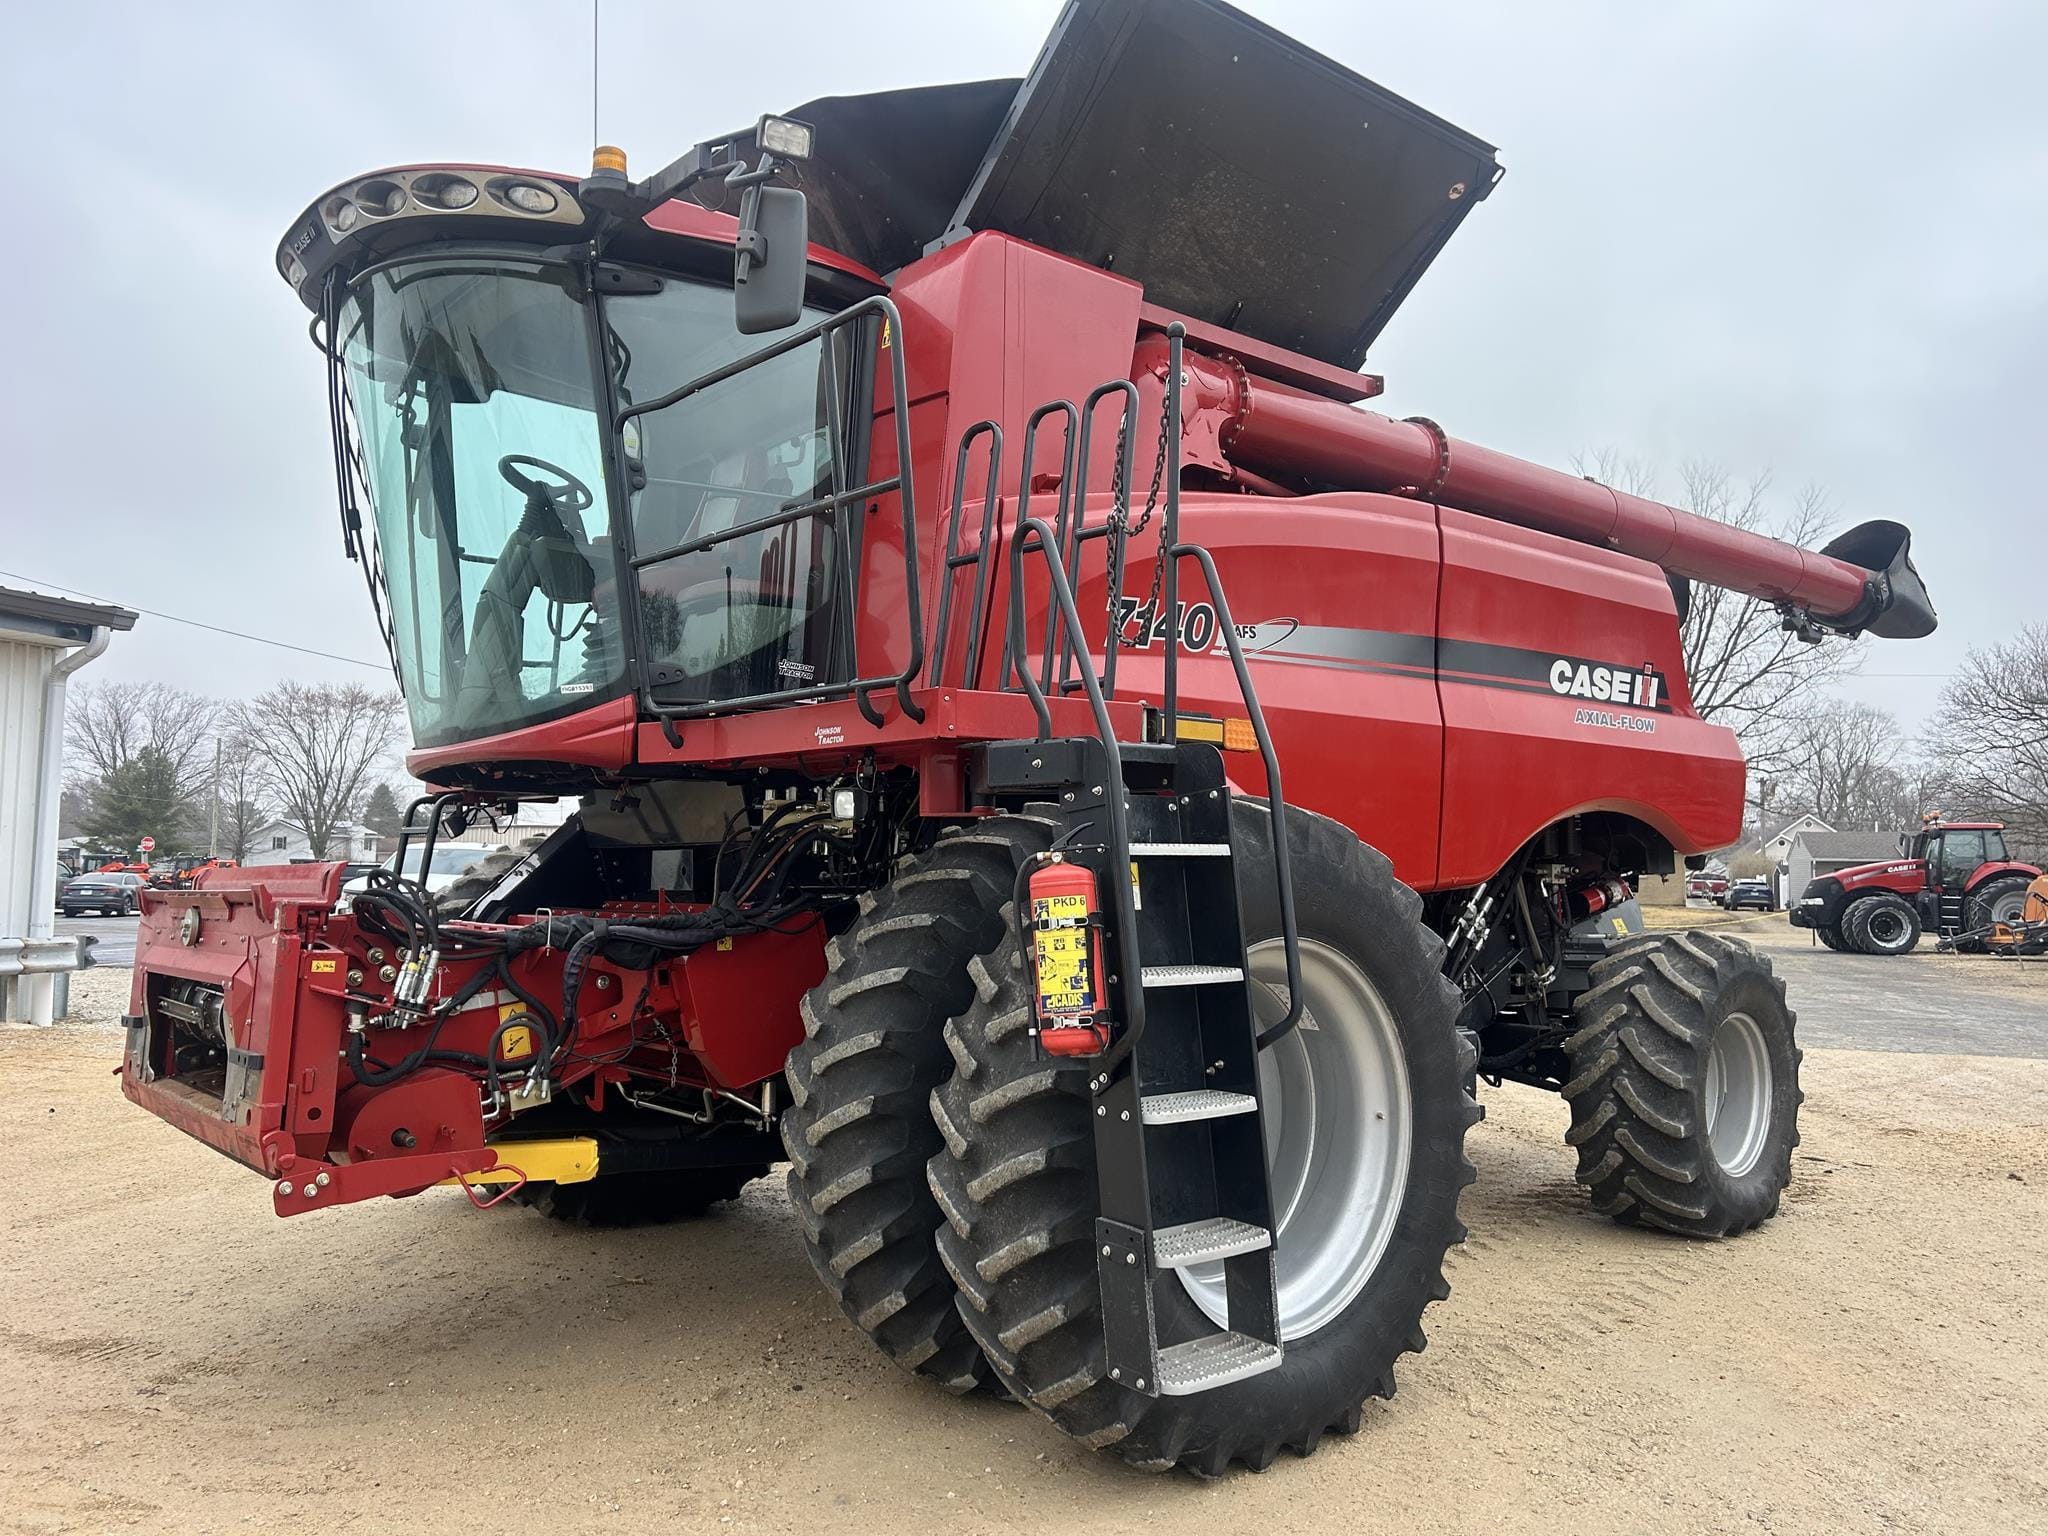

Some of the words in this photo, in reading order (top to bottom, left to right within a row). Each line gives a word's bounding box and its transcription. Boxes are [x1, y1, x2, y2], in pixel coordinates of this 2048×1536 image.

[1104, 597, 1214, 652] 7140
[1234, 624, 1257, 639] AFS
[778, 659, 815, 673] JOHNSON
[779, 668, 814, 680] TRACTOR
[1574, 709, 1656, 733] AXIAL-FLOW
[814, 726, 842, 737] JOHNSON
[818, 735, 844, 745] TRACTOR
[1053, 896, 1077, 908] PKD
[1079, 896, 1086, 906] 6
